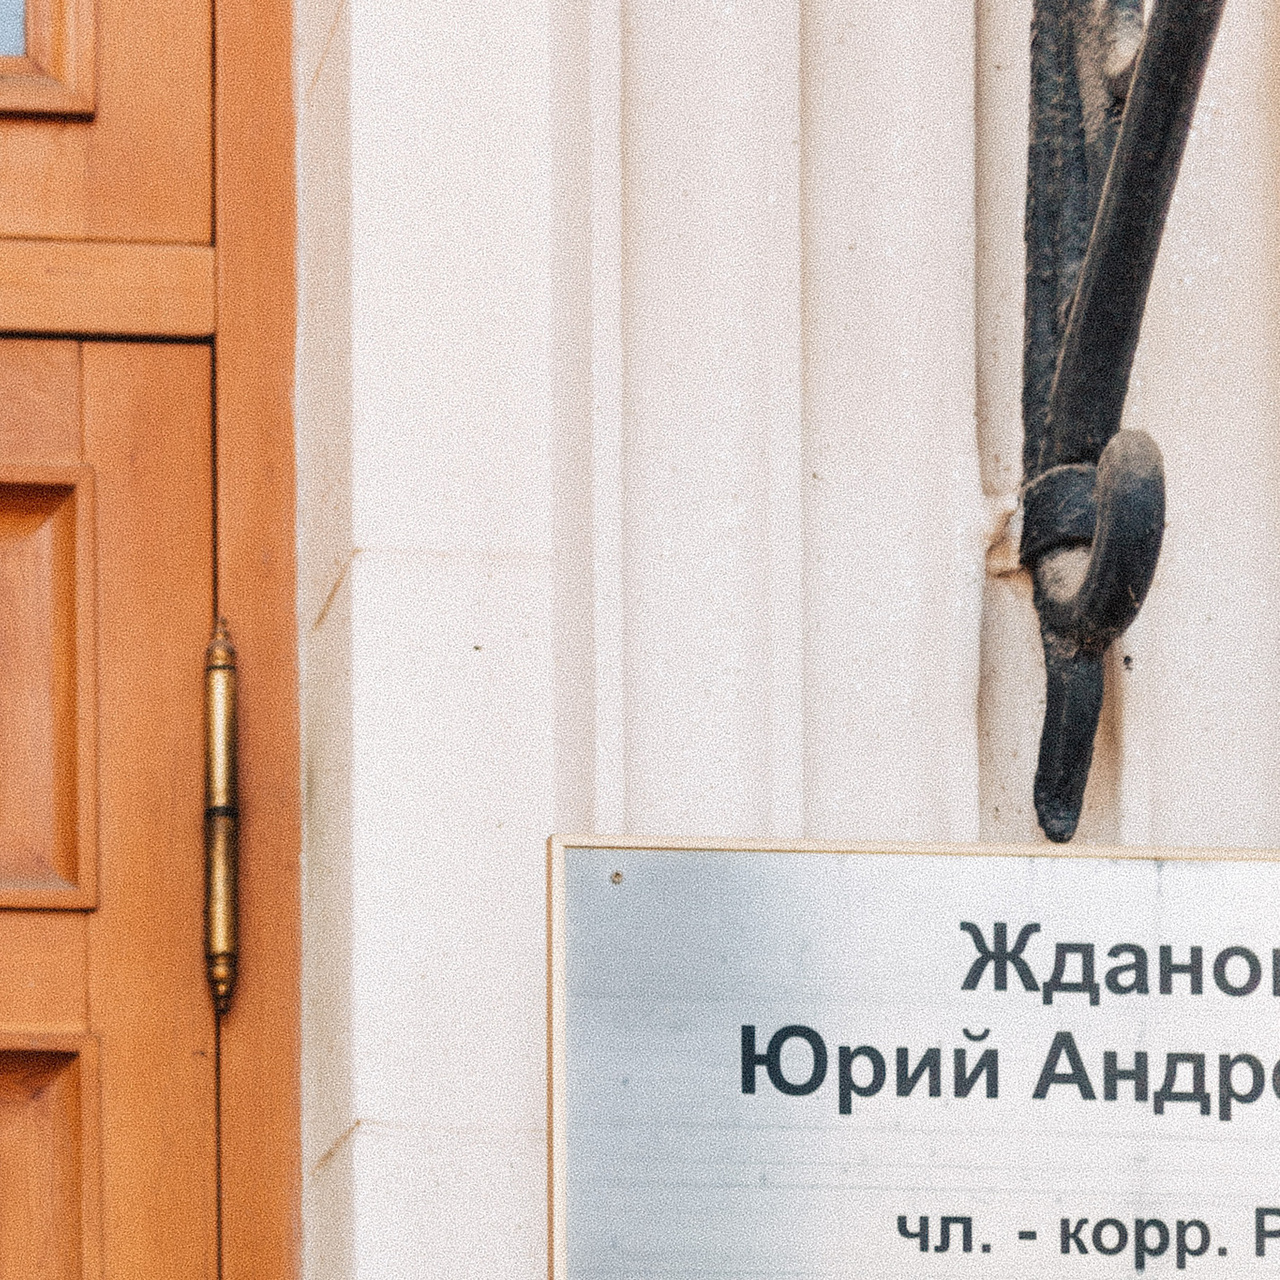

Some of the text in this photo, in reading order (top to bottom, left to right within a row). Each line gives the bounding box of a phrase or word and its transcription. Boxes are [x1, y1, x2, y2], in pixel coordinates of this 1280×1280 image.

[959, 921, 1280, 1007] Ждано
[739, 1023, 1280, 1122] Юрий Андр
[896, 1214, 992, 1254] чл.
[1059, 1217, 1228, 1271] корр.
